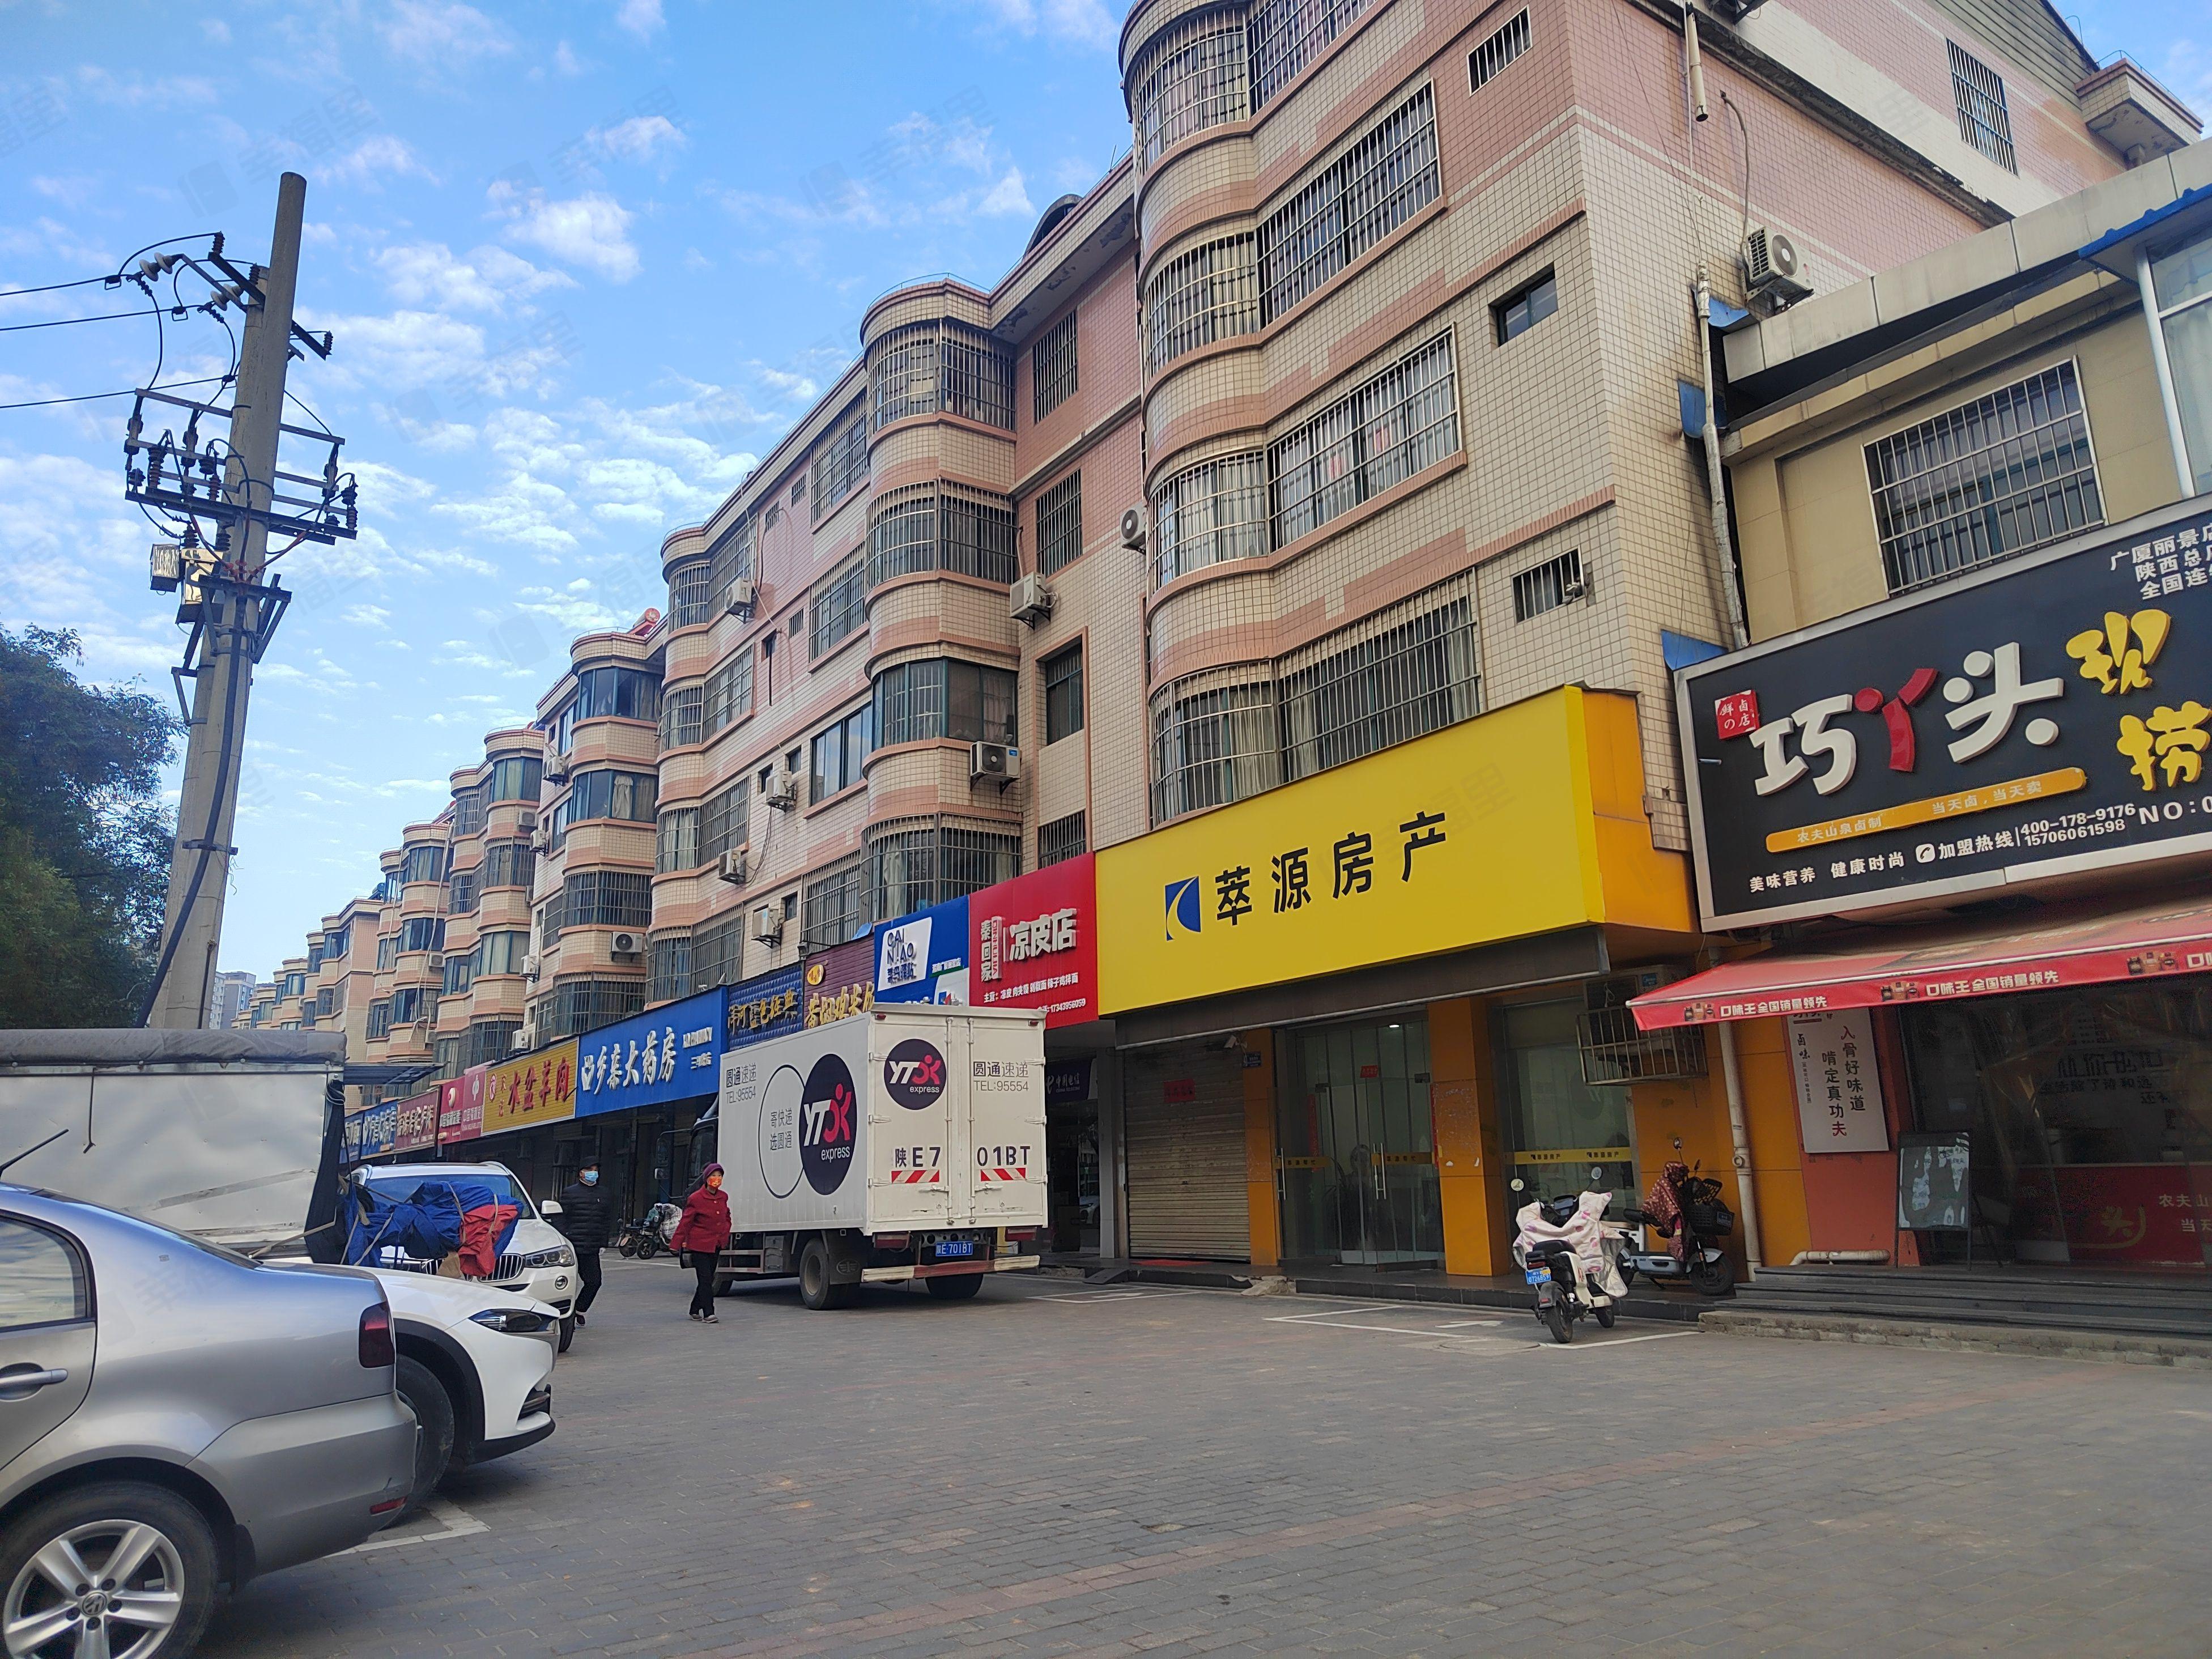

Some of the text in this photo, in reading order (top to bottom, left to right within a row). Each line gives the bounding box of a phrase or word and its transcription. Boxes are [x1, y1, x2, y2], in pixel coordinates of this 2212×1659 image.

[2140, 564, 2212, 600] 全国连
[1749, 642, 2063, 796] 巧丫头
[1797, 816, 1882, 843] 农夫山泉卤制
[2020, 803, 2136, 835] 400-178-9176
[1938, 819, 2125, 860] 加盟热线 15706061598
[1215, 810, 1447, 926] 萃源房产
[1749, 852, 1904, 893] 美味营养 健康时尚
[887, 928, 905, 947] CAI
[1010, 908, 1077, 961] 凉皮店
[887, 942, 914, 964] NIAO
[1926, 971, 2058, 996] 口味王全国销量领先
[1720, 996, 1827, 1018] 口味王全国销量领先
[726, 1063, 756, 1088] 圆通速递
[973, 1061, 1029, 1078] 圆通速递
[1841, 1026, 1865, 1111] 入骨好味道
[508, 1056, 570, 1113] 水盆羊肉
[726, 1085, 756, 1104] TEL:95554
[909, 1086, 939, 1094] express
[973, 1080, 1029, 1091] TEL:95554
[1822, 1051, 1847, 1136] 啃定真功夫
[770, 1108, 792, 1128] 寄快递
[769, 1131, 792, 1151] 选圆通
[822, 1146, 850, 1163] express
